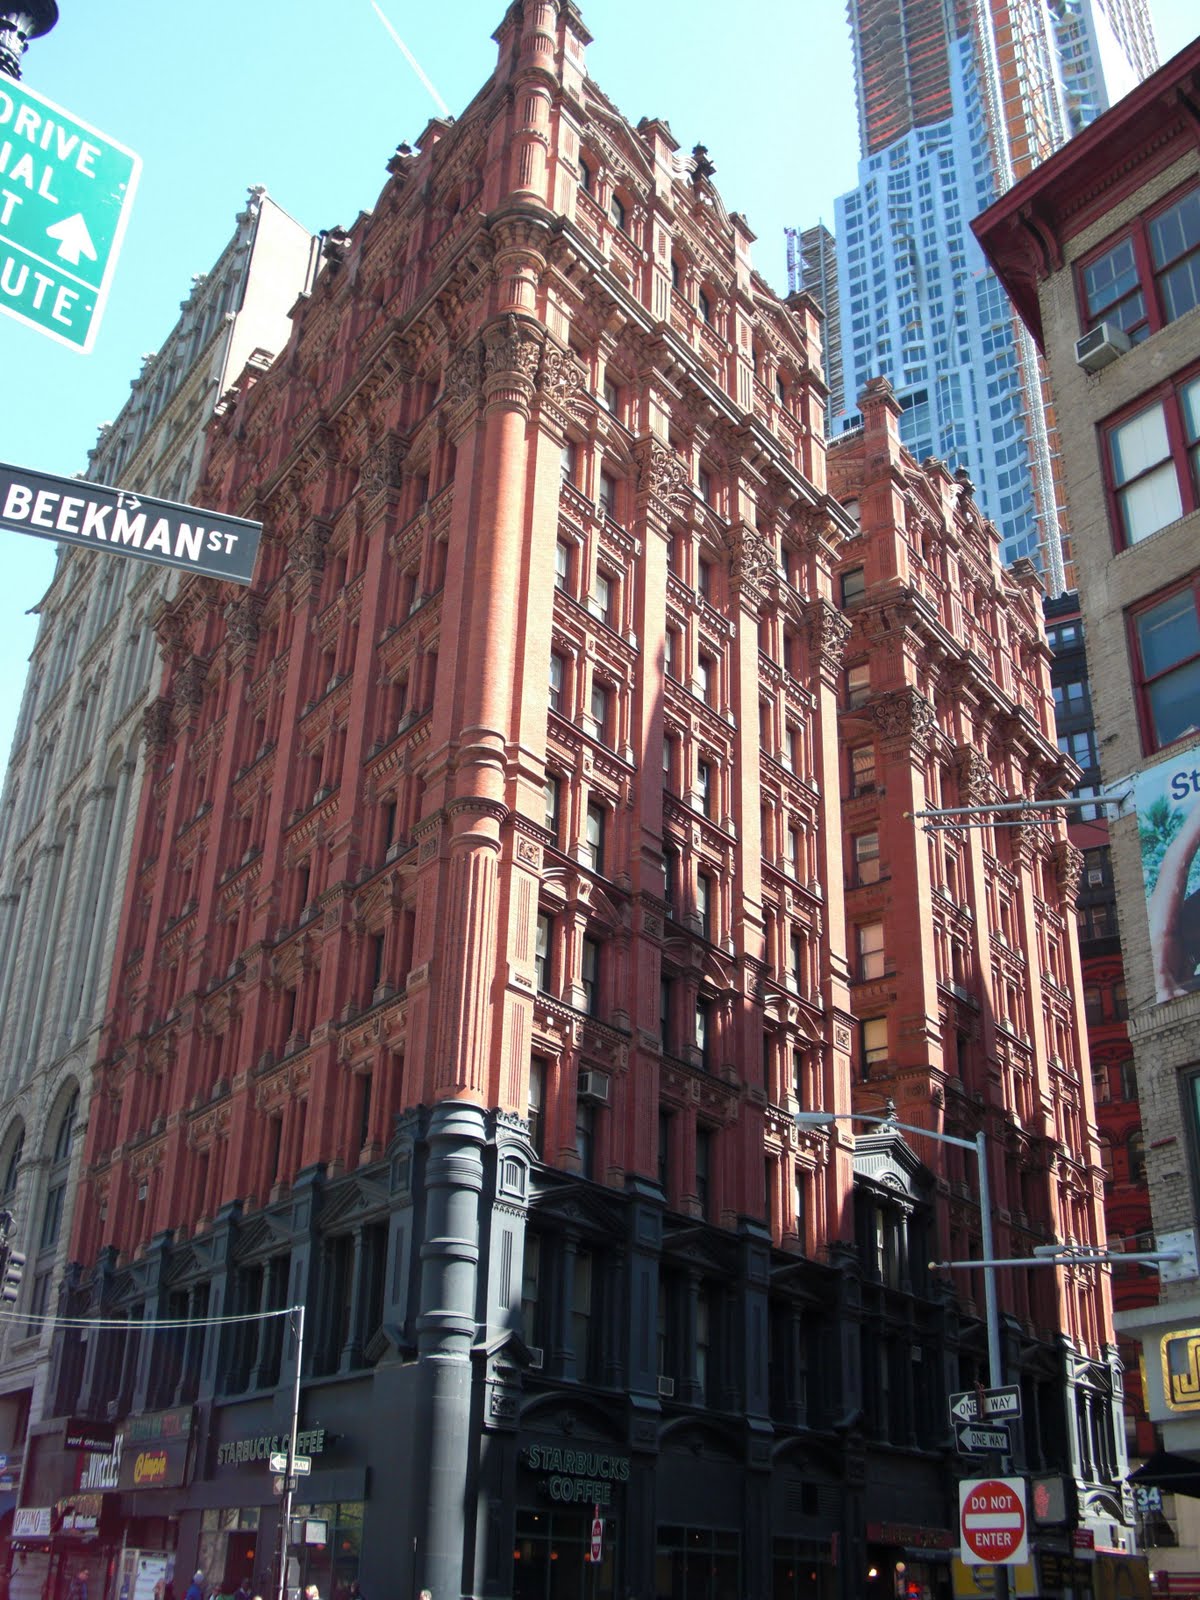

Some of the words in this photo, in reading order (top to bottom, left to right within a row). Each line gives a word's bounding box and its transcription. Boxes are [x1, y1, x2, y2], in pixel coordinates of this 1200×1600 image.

[2, 483, 205, 561] BEEKMAN
[206, 530, 239, 555] ST
[959, 1402, 977, 1415] ONE
[990, 1396, 1011, 1410] WAY
[217, 1435, 278, 1465] STARBUCKS
[281, 1429, 325, 1454] CFFEE
[971, 1432, 987, 1446] ONE
[988, 1433, 1005, 1447] WAY
[528, 1444, 631, 1481] STARBUCKS
[549, 1475, 611, 1505] COFFEE
[1136, 1486, 1160, 1506] 34
[971, 1496, 987, 1510] DO
[990, 1495, 1013, 1510] NOT
[975, 1532, 1011, 1546] ENTER
